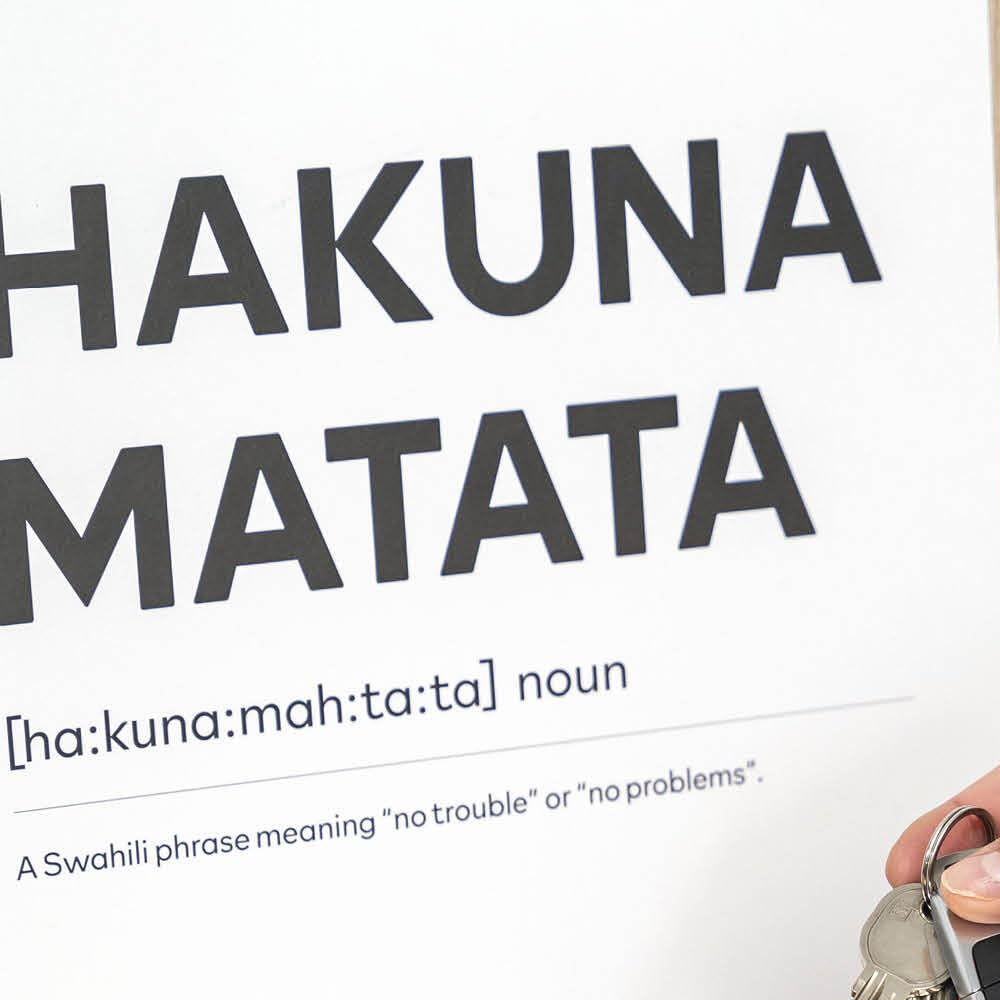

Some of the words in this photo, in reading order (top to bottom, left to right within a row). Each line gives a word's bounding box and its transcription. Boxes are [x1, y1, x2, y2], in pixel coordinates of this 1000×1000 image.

[0, 130, 882, 359] HAKUNA
[0, 387, 816, 626] MATATA
[6, 657, 497, 772] [ha:kuna:mah:ta:ta]
[518, 661, 628, 702] noun
[16, 855, 38, 881] A
[43, 839, 148, 877] Swahili
[155, 833, 250, 868] phrase
[256, 813, 376, 849] meaning
[545, 790, 571, 810] or
